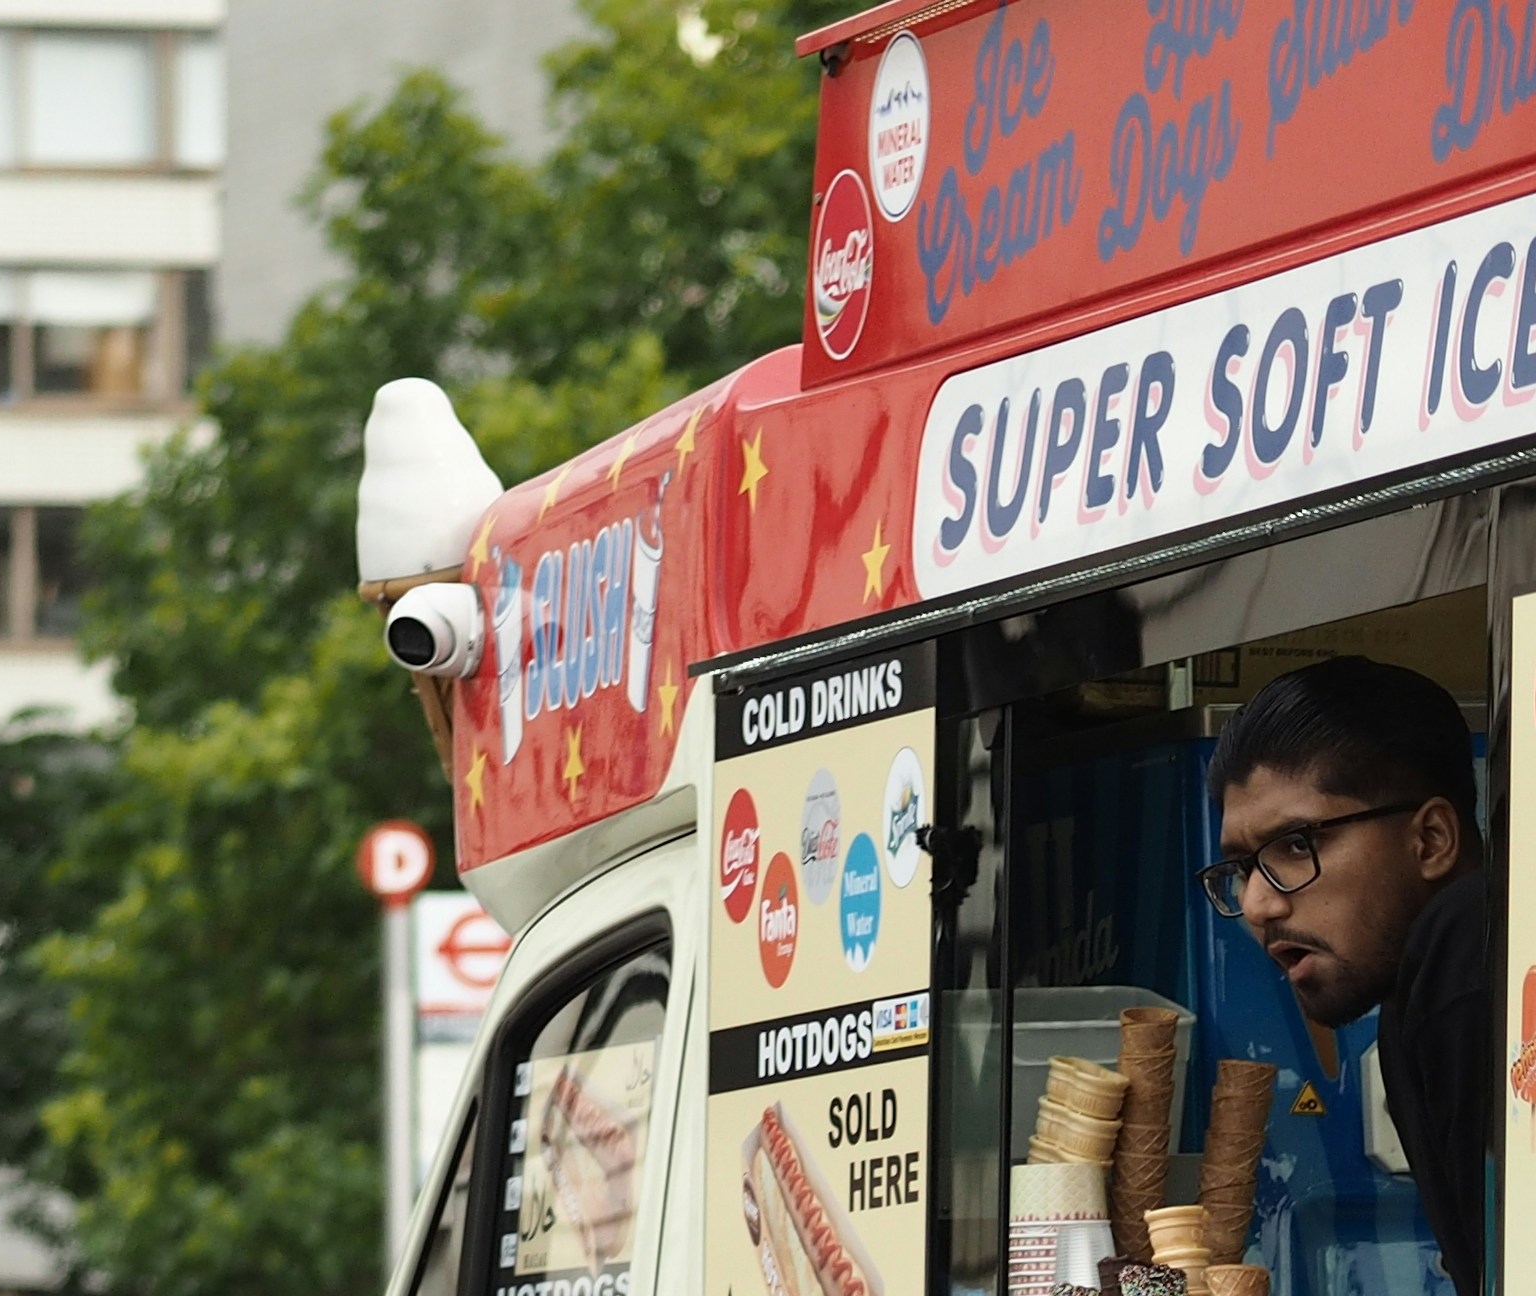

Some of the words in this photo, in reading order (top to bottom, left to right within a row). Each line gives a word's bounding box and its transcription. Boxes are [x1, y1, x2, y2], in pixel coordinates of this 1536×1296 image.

[964, 0, 1056, 175] Ice
[877, 118, 922, 159] MINERAL
[882, 155, 915, 191] WATER
[1097, 79, 1241, 263] Dogs
[918, 129, 1083, 326] Cream
[816, 228, 873, 297] Coca-Cola
[935, 352, 1175, 560] SUPER
[1197, 279, 1405, 488] SOFT
[526, 517, 633, 720] SLUSH
[742, 686, 806, 746] COLD
[811, 659, 903, 729] DRINKS
[844, 868, 878, 895] Mineral
[761, 900, 796, 943] Fanta
[846, 911, 875, 938] Water
[758, 1010, 873, 1079] HOTDOGS
[828, 1087, 898, 1149] SOLD
[848, 1151, 920, 1214] HERE
